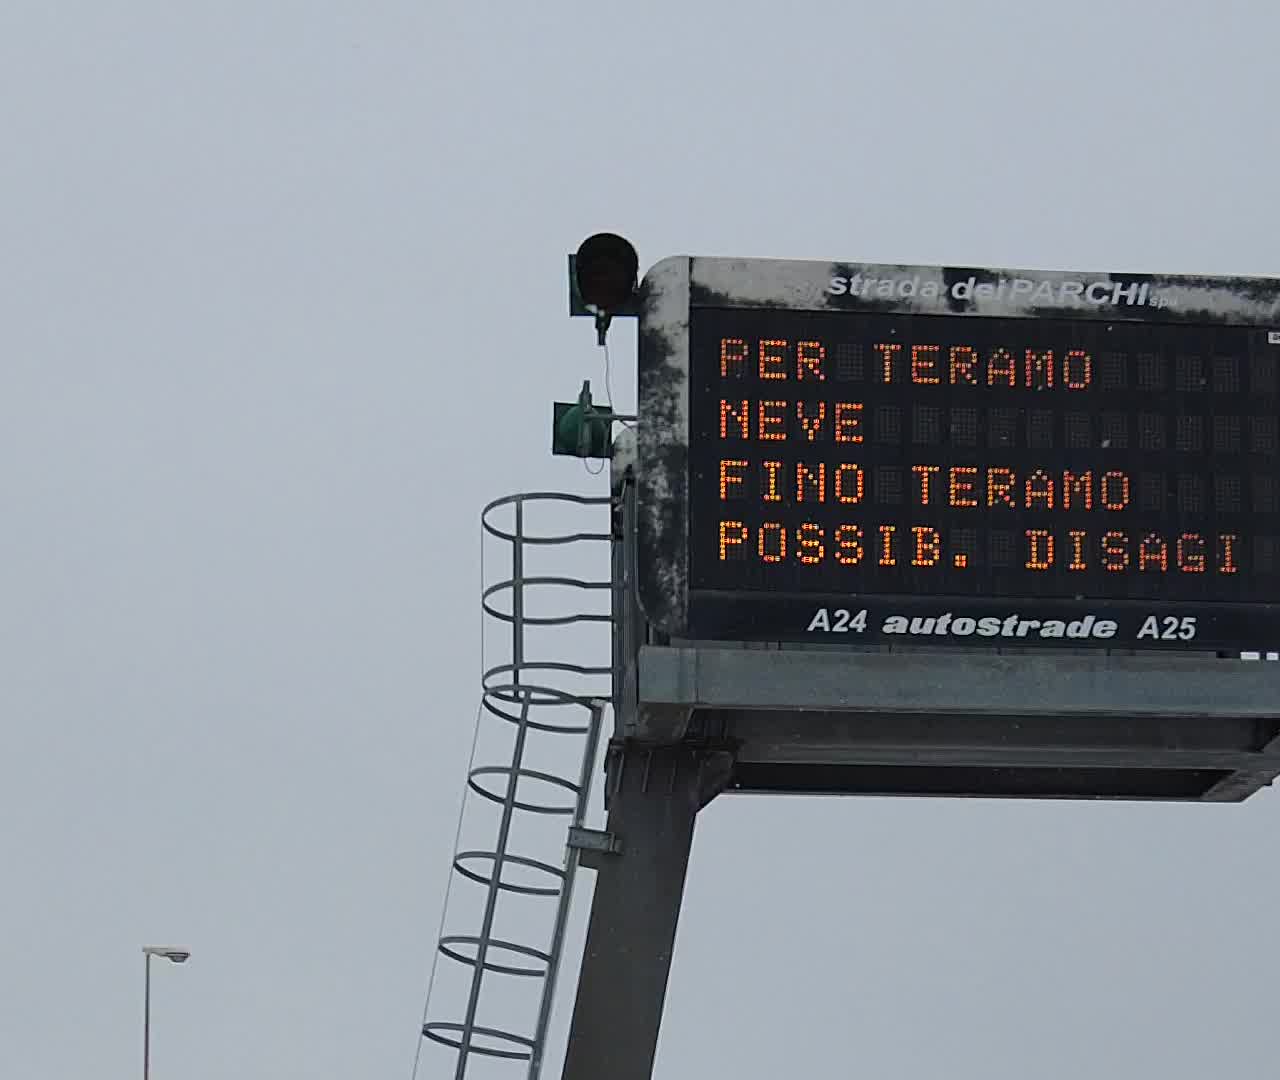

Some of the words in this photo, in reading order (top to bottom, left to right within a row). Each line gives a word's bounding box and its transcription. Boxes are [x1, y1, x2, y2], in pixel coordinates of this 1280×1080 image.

[827, 273, 940, 299] strada
[719, 338, 826, 380] PER
[874, 343, 1092, 390] TERAMO
[719, 399, 865, 443] NEVE
[719, 459, 865, 504] FINO
[911, 465, 1131, 511] TERAMO
[719, 520, 968, 569] POSSIB.
[1025, 530, 1241, 574] DISAGI
[807, 608, 868, 634] A24
[881, 612, 1118, 640] autostrade
[1136, 615, 1198, 641] A25
